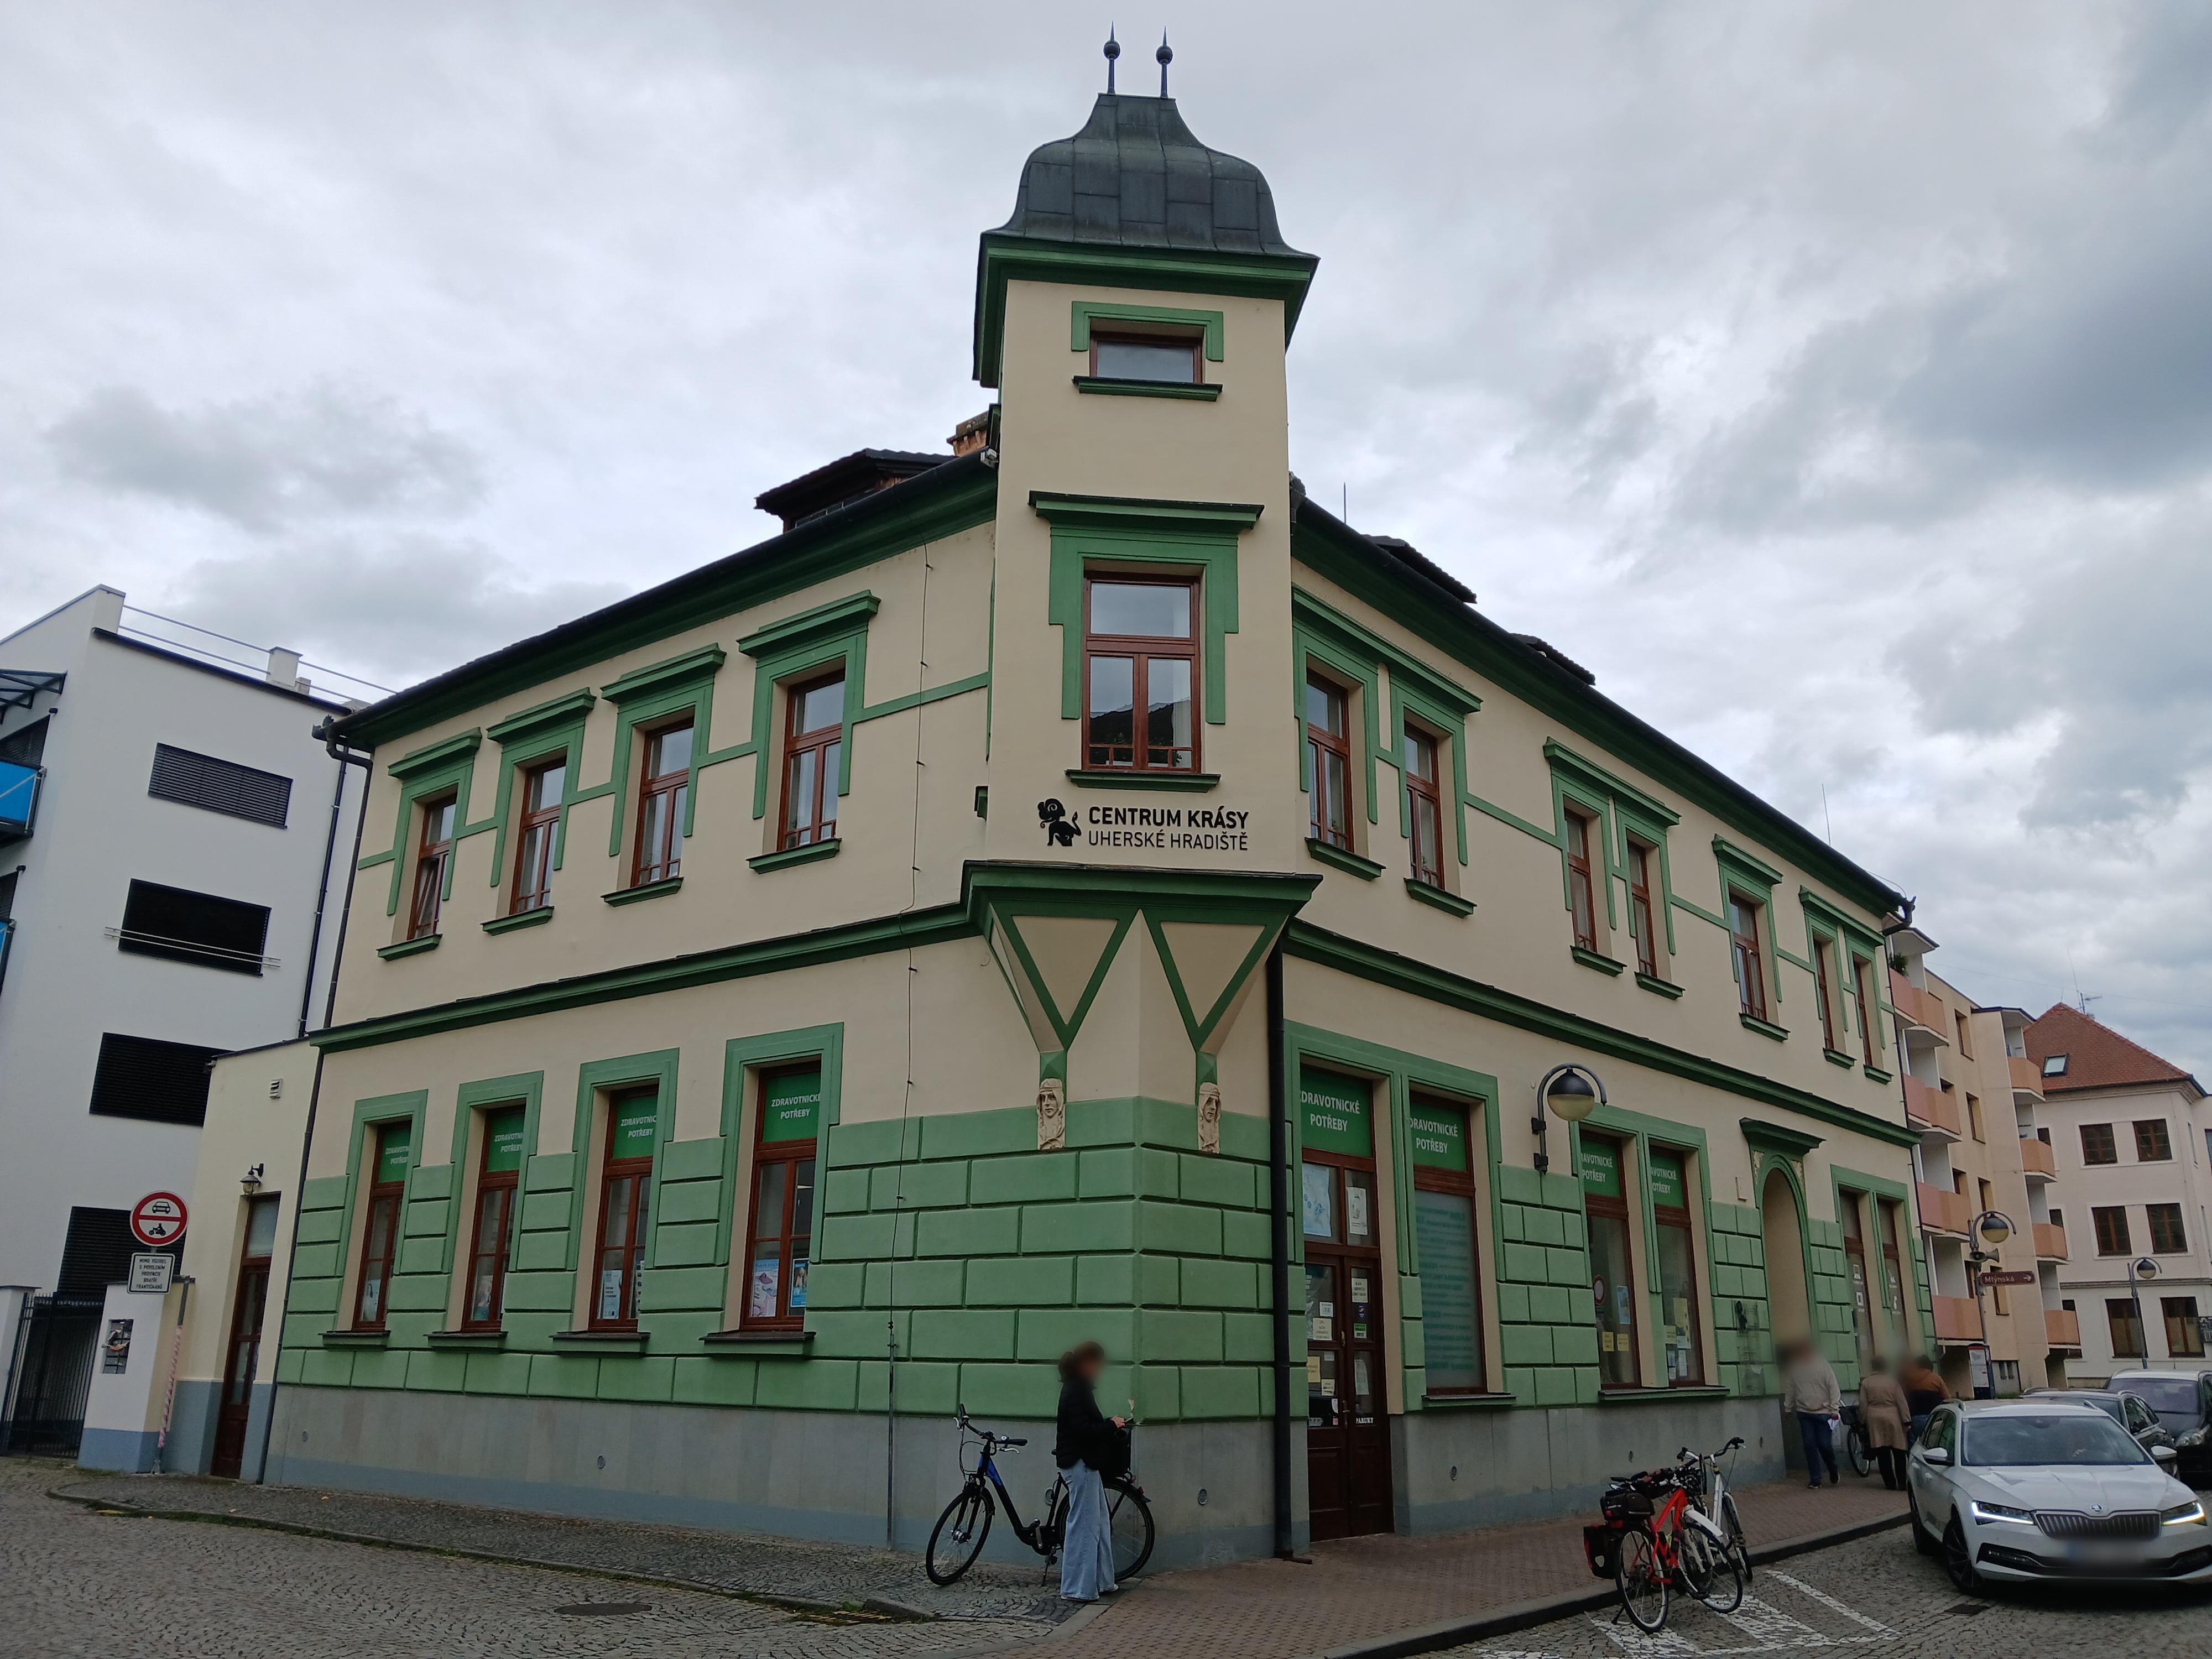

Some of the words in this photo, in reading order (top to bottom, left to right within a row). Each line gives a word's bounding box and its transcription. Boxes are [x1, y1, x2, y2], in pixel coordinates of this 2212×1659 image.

[1089, 806, 1181, 827] CENTRUM
[1188, 806, 1249, 829] KRÁSY
[1089, 830, 1165, 848] UHERSKÉ
[1171, 831, 1248, 851] HRADIŠTĚ
[1301, 1090, 1360, 1114] DRAVOTNICKÉ
[780, 1108, 811, 1119] POTŘEBY
[620, 1115, 657, 1126] ZDRAVOTNIC
[1310, 1113, 1348, 1132] POTŘEBY
[628, 1128, 654, 1138] POTŘEBY
[1410, 1118, 1458, 1137] DRAVOTNICKÉ
[1416, 1138, 1448, 1154] POTŘEBY
[1582, 1169, 1606, 1182] POTŘEBY
[1650, 1167, 1677, 1180] AVOTNICKÉ
[1652, 1182, 1671, 1194] OTŘEBY
[1984, 1275, 2015, 1284] Mlýnská
